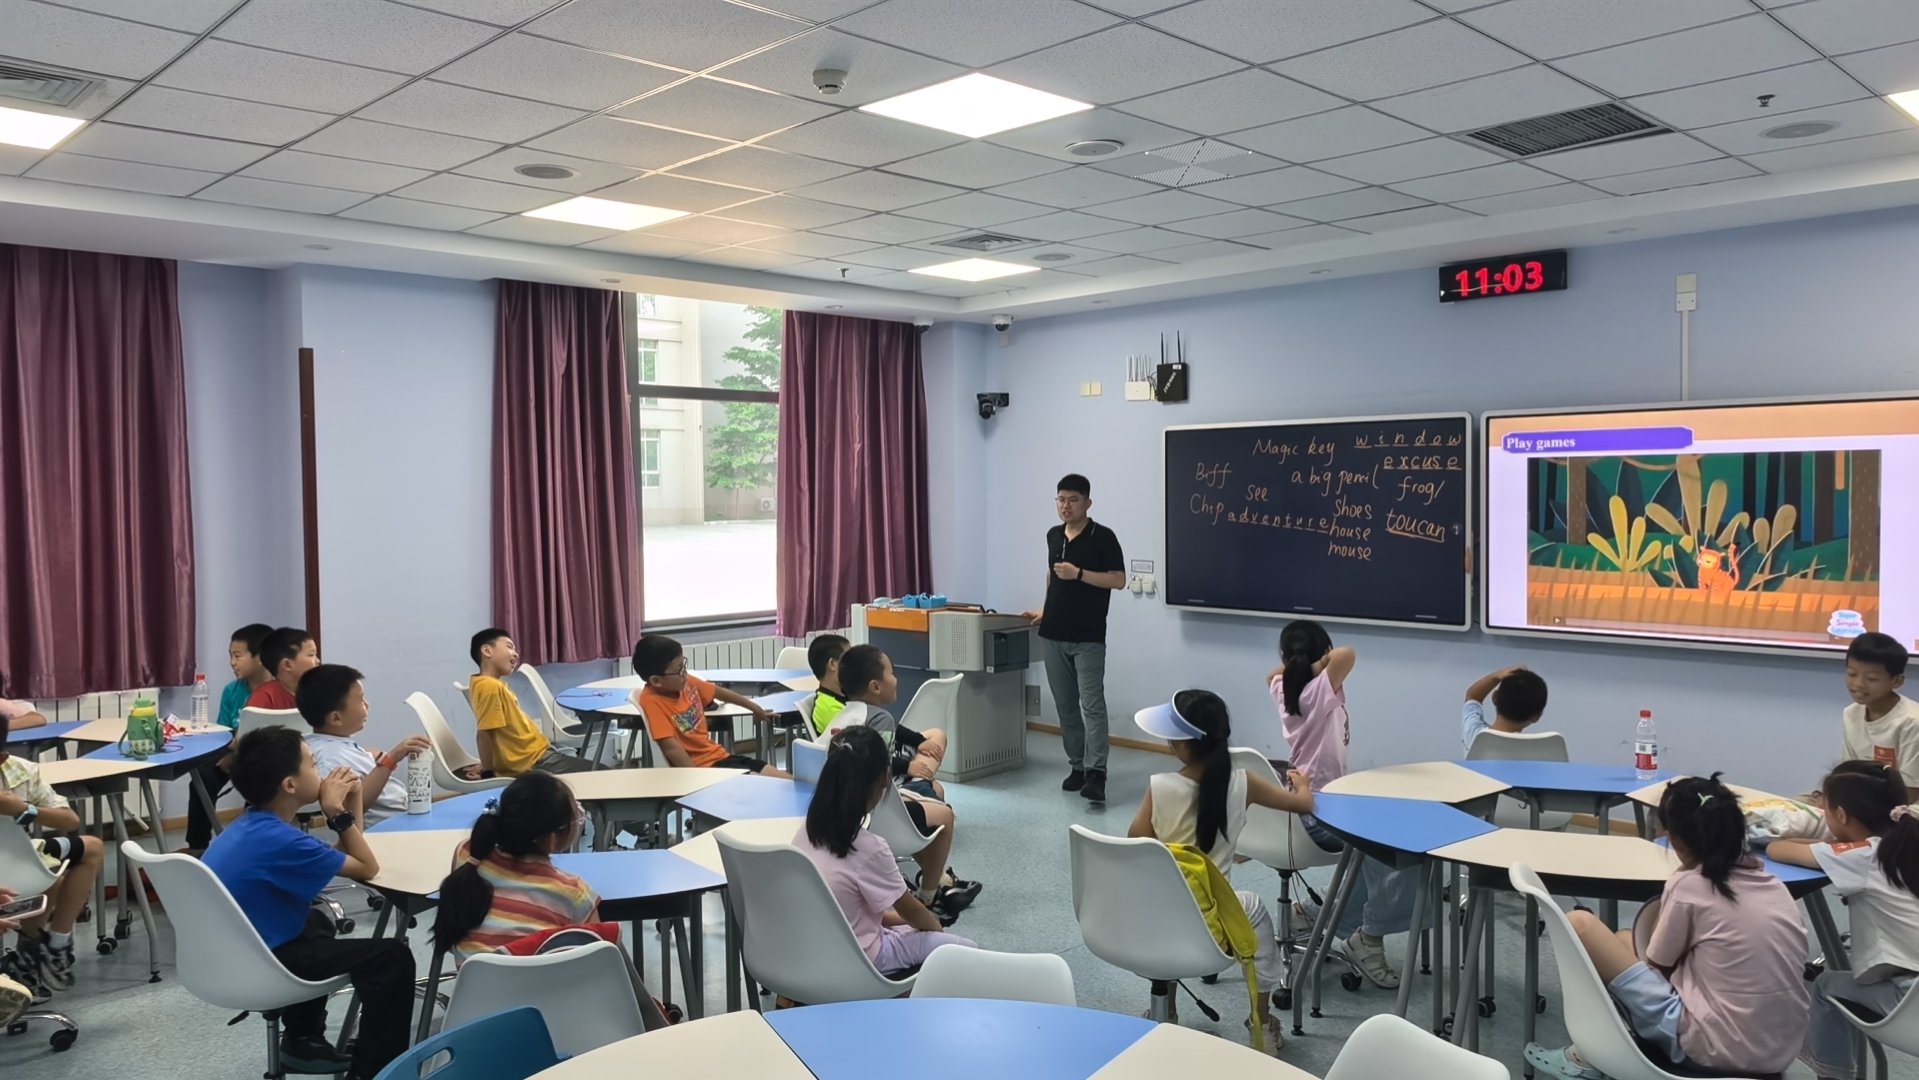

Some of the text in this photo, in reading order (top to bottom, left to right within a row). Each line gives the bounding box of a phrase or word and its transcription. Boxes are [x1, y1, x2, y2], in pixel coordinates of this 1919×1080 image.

[1455, 261, 1544, 297] 11:03
[1252, 436, 1335, 467] Magic key
[1354, 429, 1462, 449] window
[1506, 437, 1577, 451] Play games
[1194, 462, 1233, 489] Biff
[1383, 455, 1462, 471] excuse
[1291, 463, 1379, 497] a big pencil
[1189, 493, 1224, 526] Chip
[1227, 505, 1329, 534] adventure
[1329, 517, 1372, 541] house
[1385, 508, 1445, 543] toucan
[1327, 540, 1372, 561] mouse
